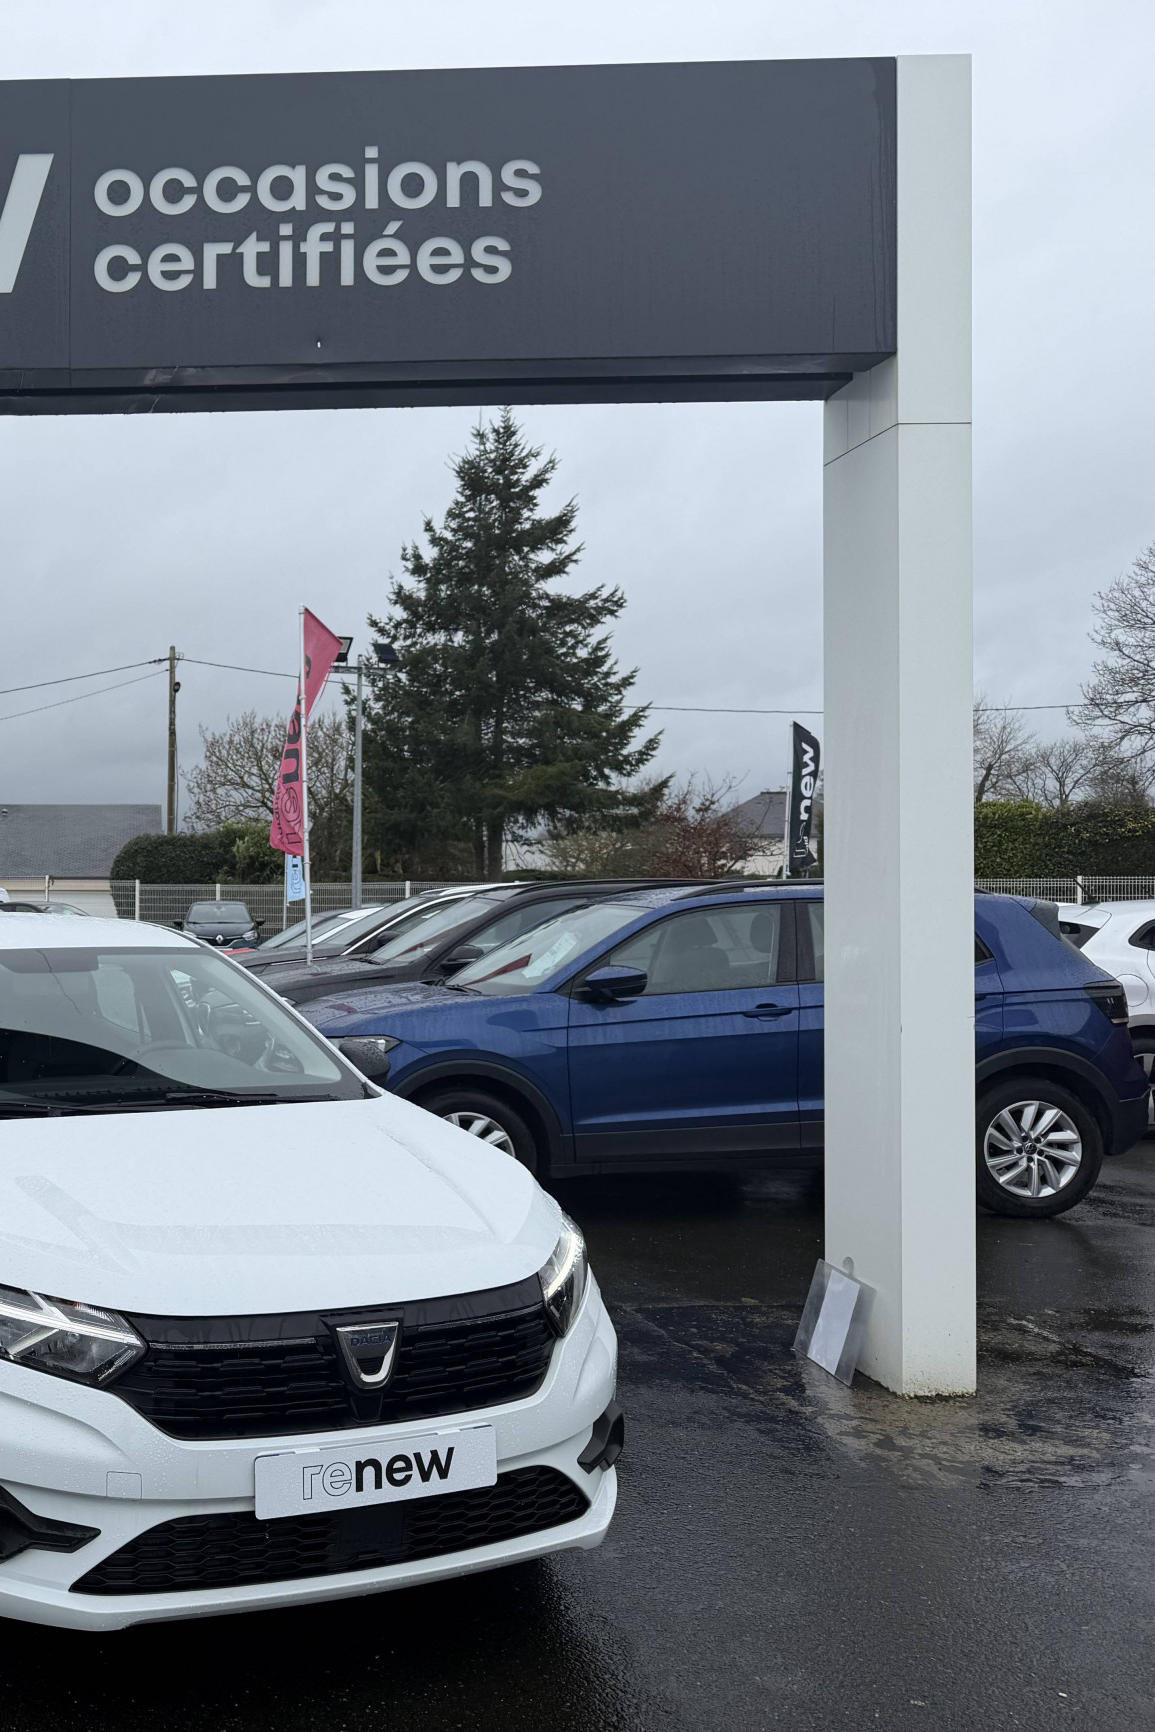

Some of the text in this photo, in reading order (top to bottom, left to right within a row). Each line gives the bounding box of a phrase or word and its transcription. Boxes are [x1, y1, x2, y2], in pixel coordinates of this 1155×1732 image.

[93, 146, 544, 217] occasions
[93, 219, 514, 294] certifiées
[350, 1332, 392, 1348] DACIA
[302, 1446, 455, 1501] renew
